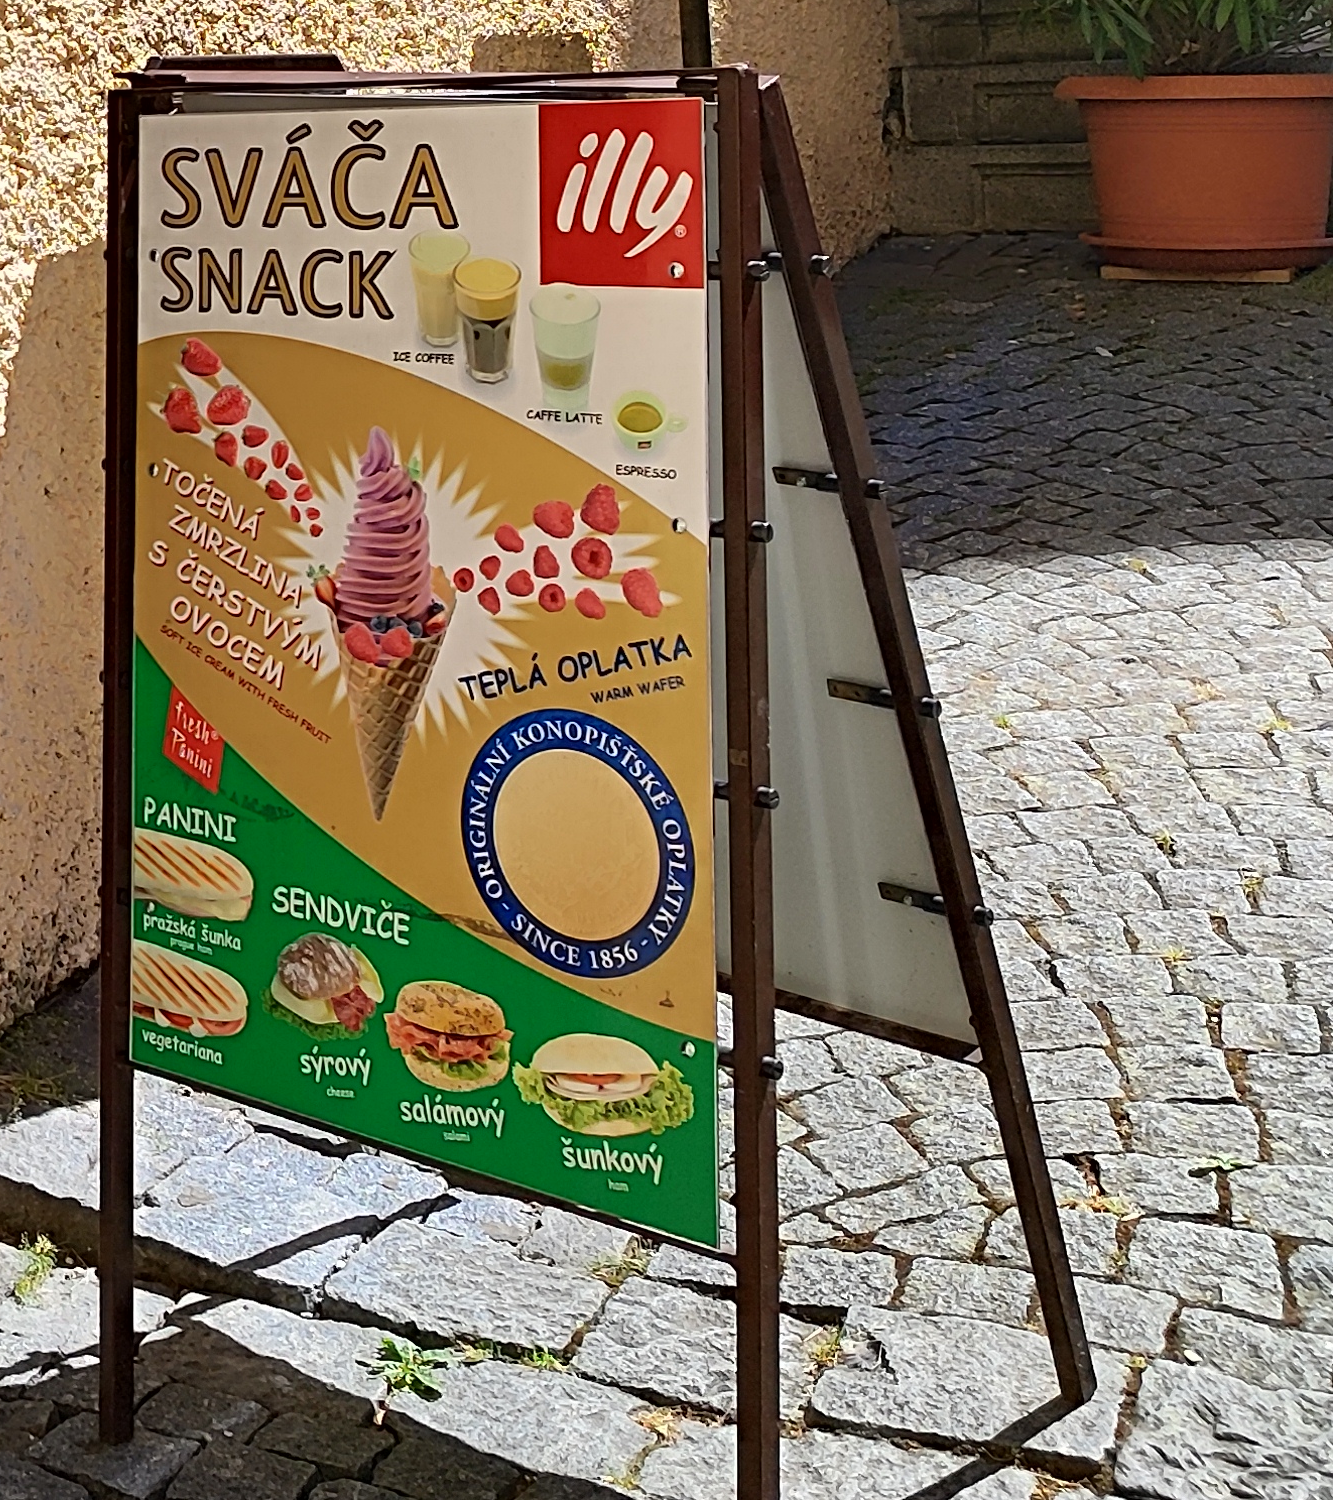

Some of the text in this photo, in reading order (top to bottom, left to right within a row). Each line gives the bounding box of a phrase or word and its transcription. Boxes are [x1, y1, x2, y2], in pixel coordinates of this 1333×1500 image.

[160, 118, 459, 231] SVÁČA
[555, 128, 694, 259] illy
[159, 245, 397, 321] SNACK
[393, 351, 455, 365] ICE COFFEE
[526, 409, 603, 425] CAFFE LATTE
[162, 457, 267, 540] TOČENÁ
[616, 464, 678, 480] ESPRESSO
[169, 504, 304, 609] ZMRZLINA
[148, 540, 323, 672] S ČERSTVÝM
[170, 596, 285, 692] OVOCEM
[458, 633, 693, 702] TEPLÁ OPLATKA
[159, 624, 332, 745] SOFT ICE CREAM WITH FRESH FRUIT
[590, 675, 686, 704] WARM WAFER
[171, 727, 214, 779] Panini
[143, 796, 238, 843] PANINI
[467, 719, 687, 947] ORIGINÁLNÍ KONOPIŠŤSKÉ OPLATKY
[142, 909, 242, 951] pražská šunka
[271, 885, 412, 946] SENDVIČE
[510, 913, 639, 970] SINCE 1856
[141, 1027, 223, 1066] vegetariana
[300, 1044, 372, 1087] sýrový
[399, 1093, 505, 1139] salámový
[560, 1136, 664, 1186] šunkový
